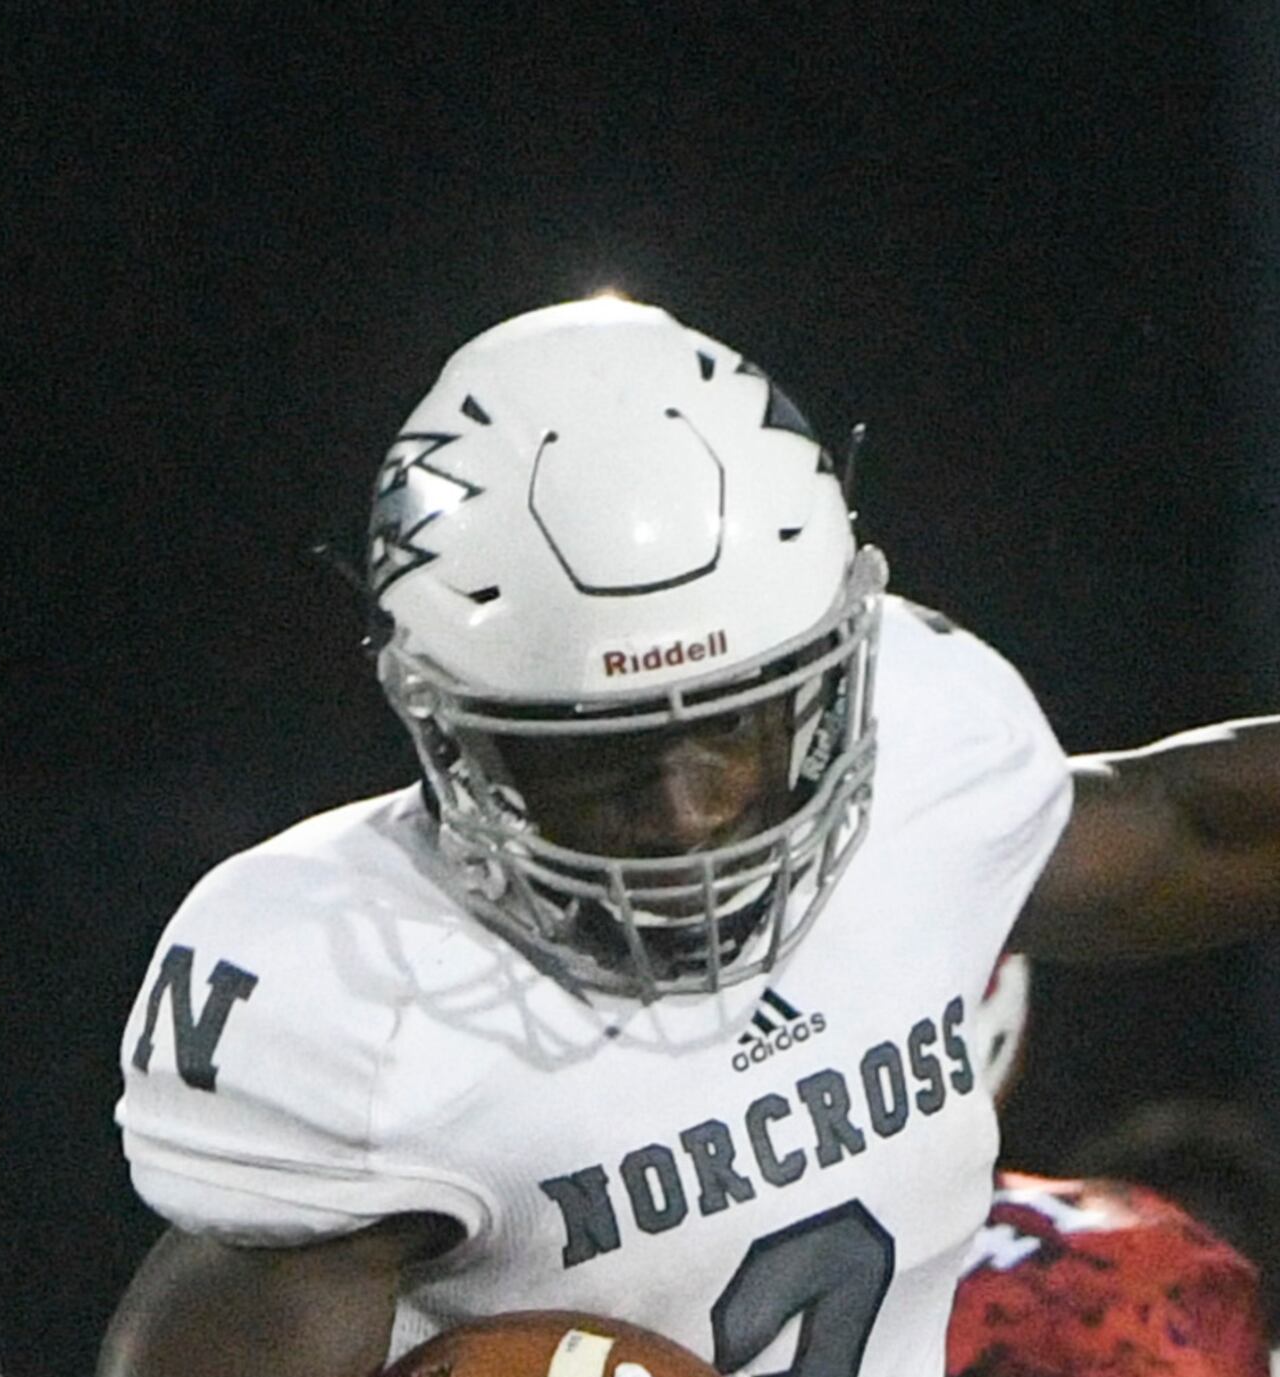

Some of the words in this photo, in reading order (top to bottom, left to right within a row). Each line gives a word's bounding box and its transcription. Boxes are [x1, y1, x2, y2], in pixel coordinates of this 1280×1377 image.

[602, 630, 729, 678] Riddell
[131, 943, 259, 1094] N
[731, 1008, 827, 1073] adidas
[540, 995, 975, 1269] NORCROSS
